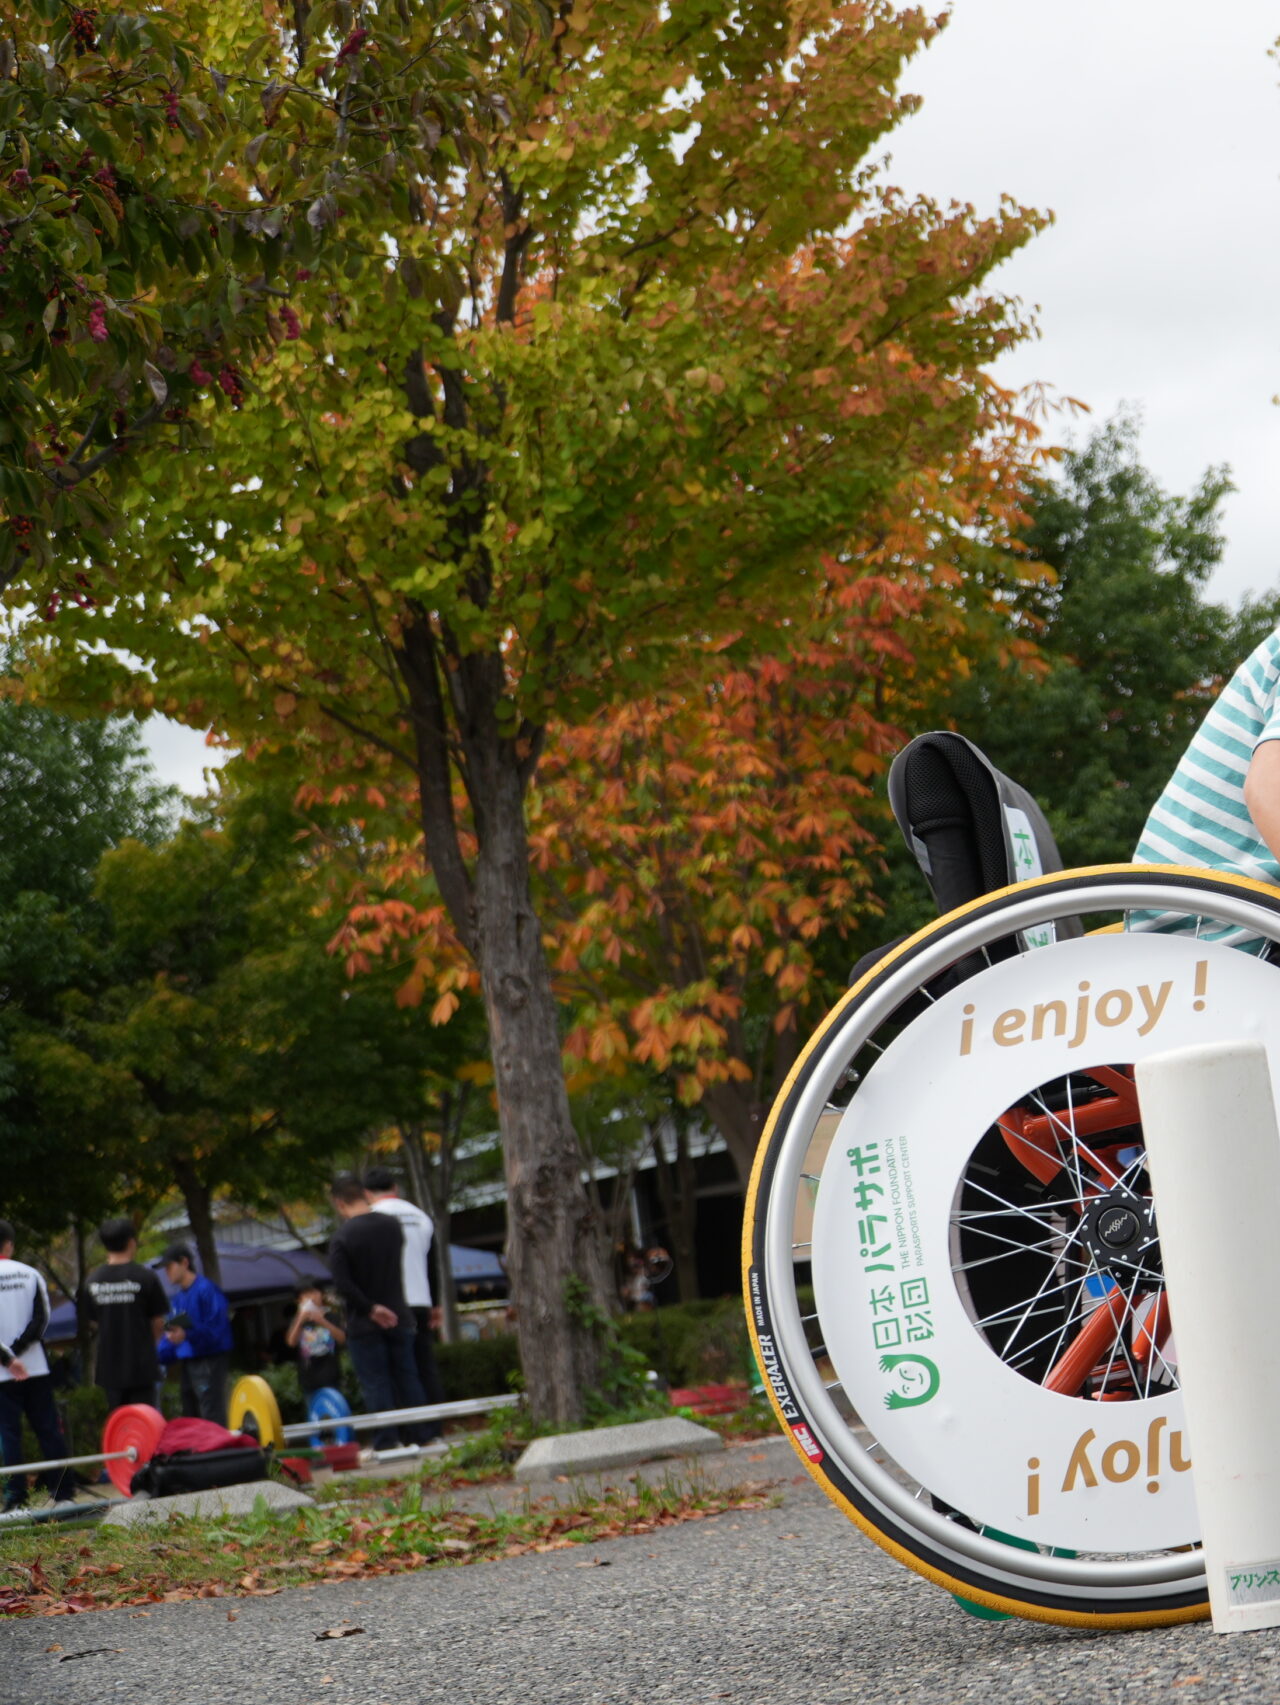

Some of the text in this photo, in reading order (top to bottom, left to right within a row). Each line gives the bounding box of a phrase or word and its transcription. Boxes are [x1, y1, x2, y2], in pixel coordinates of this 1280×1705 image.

[992, 980, 1174, 1049] enjoy
[847, 1142, 895, 1273] パラサポ
[885, 1138, 911, 1270] THE NIPPON FOUNDATION
[899, 1135, 924, 1266] PARASPORTS SUPPORT CENTER
[755, 1306, 764, 1327] MADE
[1061, 1416, 1192, 1494] njoy
